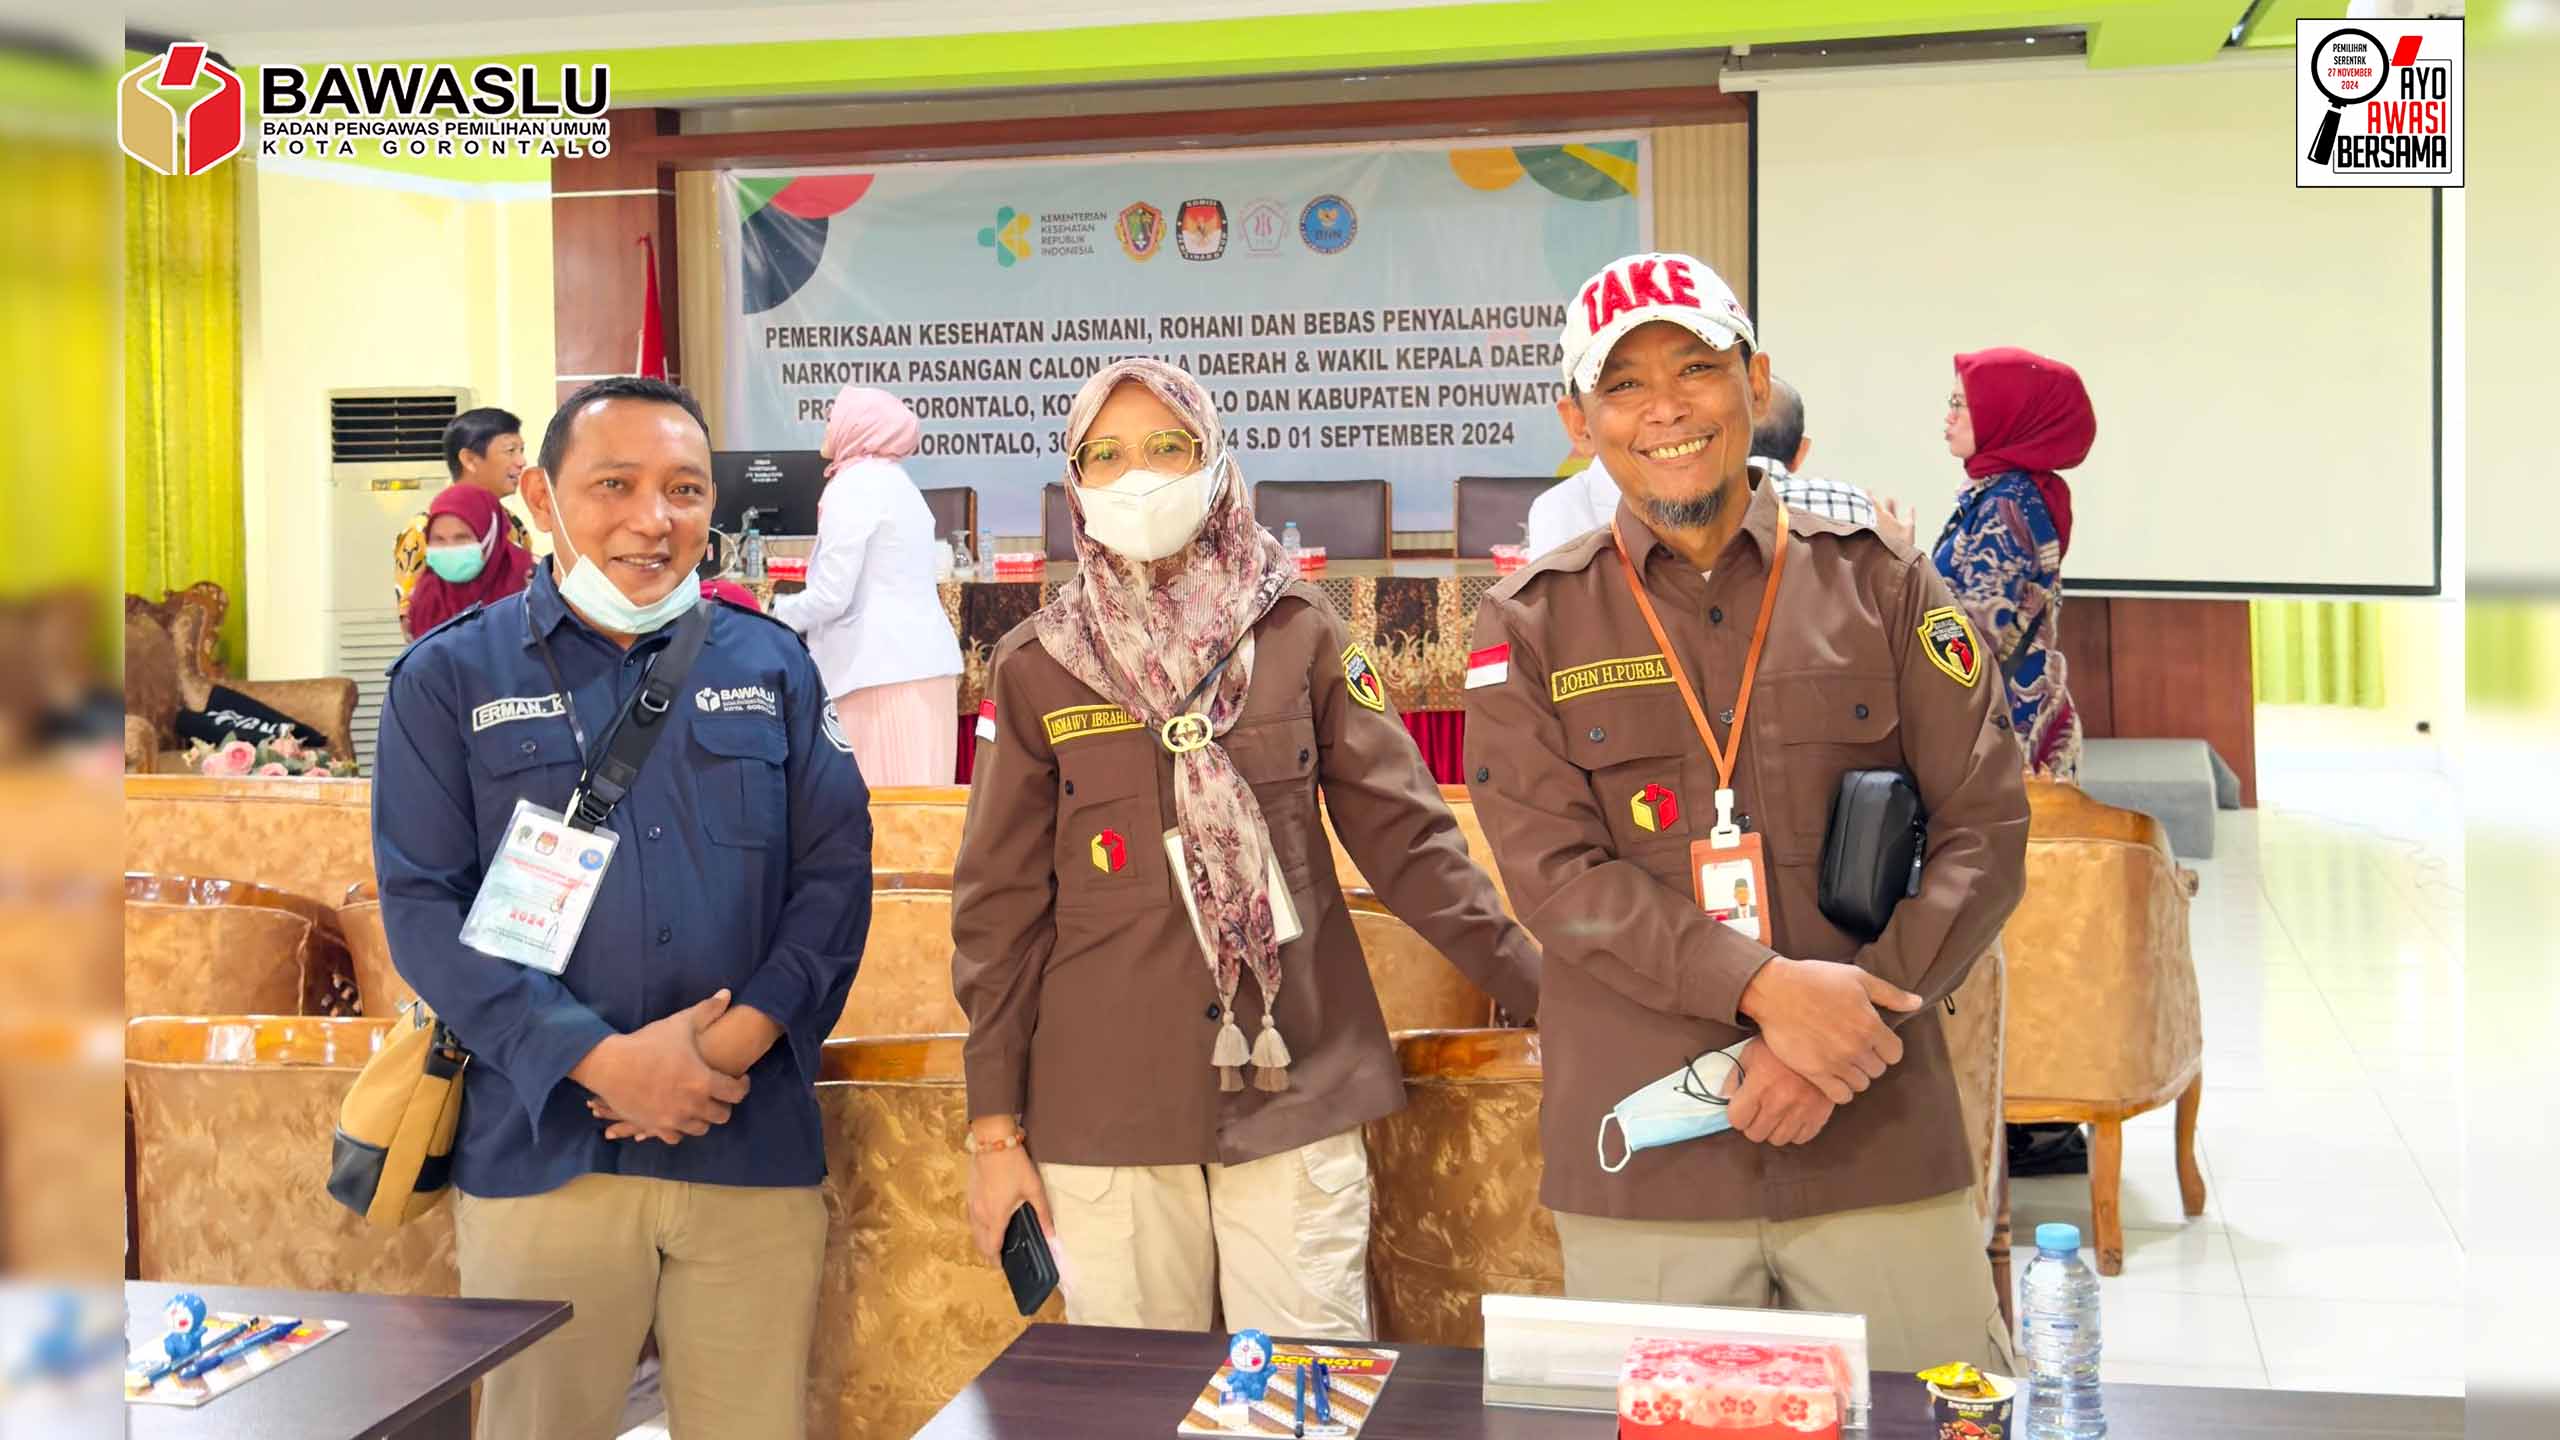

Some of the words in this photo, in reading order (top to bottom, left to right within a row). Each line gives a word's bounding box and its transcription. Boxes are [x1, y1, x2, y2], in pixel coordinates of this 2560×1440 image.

[1040, 211, 1108, 223] KEMENTERIAN
[1040, 223, 1096, 234] KESEHATAN
[1040, 234, 1086, 245] REPUBLIK
[1040, 245, 1095, 257] INDONESIA
[1582, 258, 1702, 336] TAKE
[765, 325, 912, 349] PEMERIKSAAN
[919, 320, 1045, 346] KESEHATAN
[1051, 316, 1154, 345] JASMANI,
[1160, 314, 1244, 340] ROHANI
[1251, 312, 1297, 338] DAN
[1303, 309, 1377, 336] BEBAS
[782, 361, 903, 386] NARKOTIKA
[908, 358, 1023, 383] PASANGAN
[1029, 355, 1101, 381] CALON
[1199, 351, 1288, 377] DAERAH
[1294, 349, 1312, 374] &
[1317, 347, 1390, 373] WAKIL
[1398, 345, 1485, 371] KEPALA
[1246, 388, 1292, 413] DAN
[1298, 385, 1432, 411] KABUPATEN
[911, 432, 1043, 459] ORONTALO,
[1246, 426, 1282, 450] S.D
[1288, 425, 1312, 450] 01
[1320, 423, 1457, 449] SEPTEMBER
[1461, 421, 1516, 446] 2024
[1560, 668, 1600, 695] JOHN
[1602, 660, 1668, 684] H.PURBA
[478, 701, 548, 725] ERMAN.
[1316, 1356, 1377, 1370] NOTE
